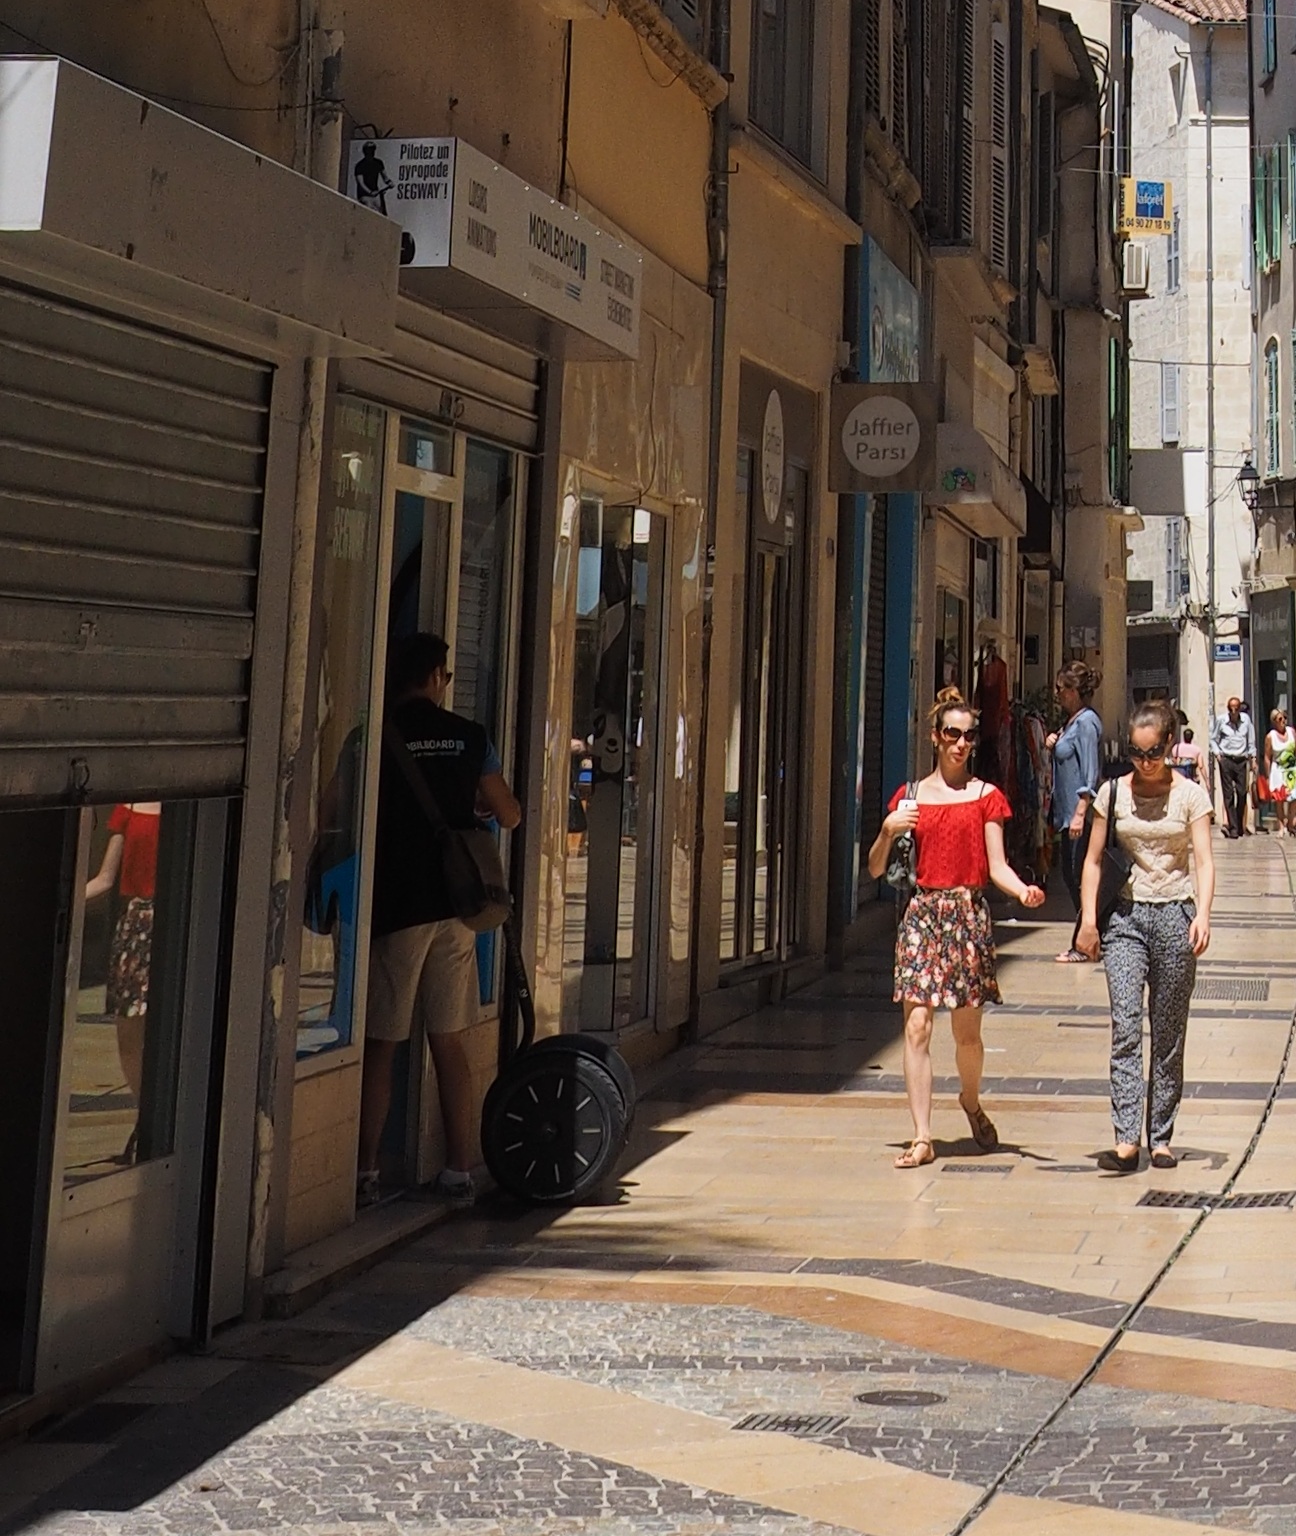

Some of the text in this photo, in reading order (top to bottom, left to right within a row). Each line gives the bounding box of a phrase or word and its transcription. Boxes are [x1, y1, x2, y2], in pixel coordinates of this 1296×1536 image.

[400, 143, 449, 160] Pilotez un
[399, 162, 448, 181] gyropode
[1126, 217, 1134, 227] 04
[1136, 218, 1144, 228] 90
[1145, 218, 1153, 228] 27
[529, 212, 579, 271] MOBILBOARD
[849, 418, 913, 436] Jaffier
[856, 443, 906, 461] Parsi
